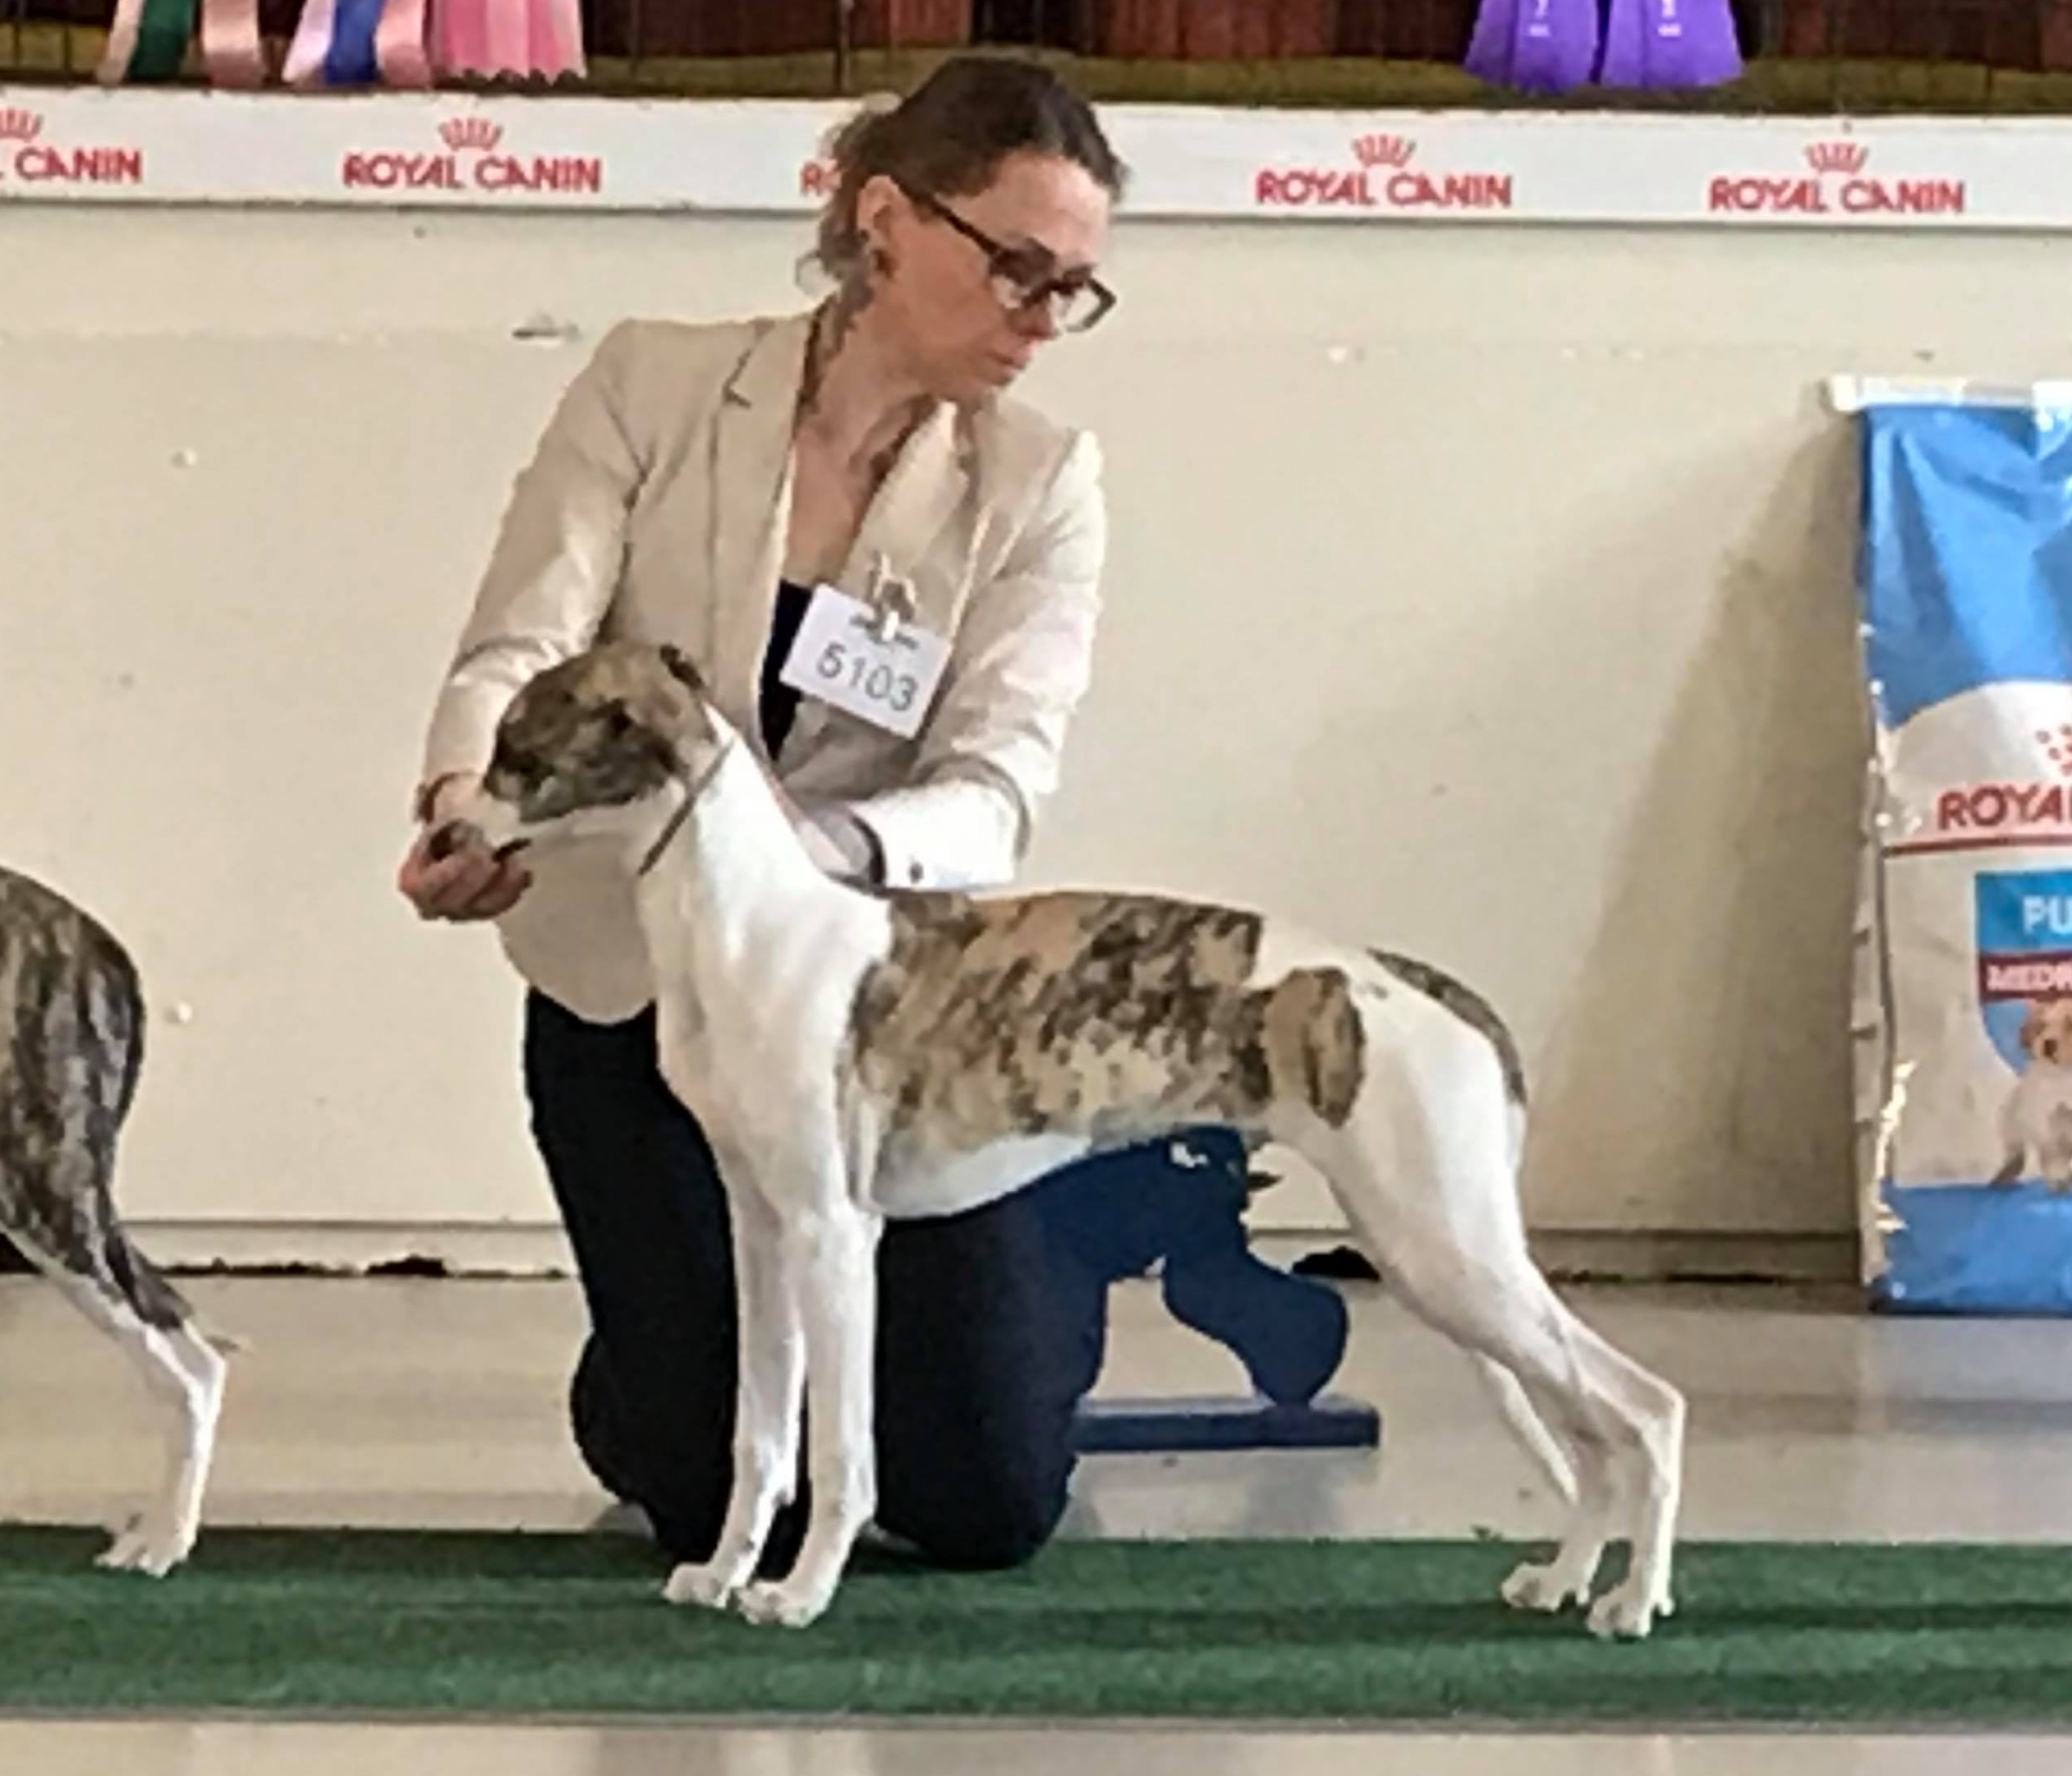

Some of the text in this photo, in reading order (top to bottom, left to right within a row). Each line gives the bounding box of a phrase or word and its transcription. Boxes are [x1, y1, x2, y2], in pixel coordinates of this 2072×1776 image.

[14, 146, 142, 184] CANIN
[343, 153, 600, 193] ROYAL CANIN
[1256, 168, 1512, 208] ROYAL CANIN
[1710, 177, 1964, 214] ROYAL CANIN
[1938, 783, 2072, 830] ROYA
